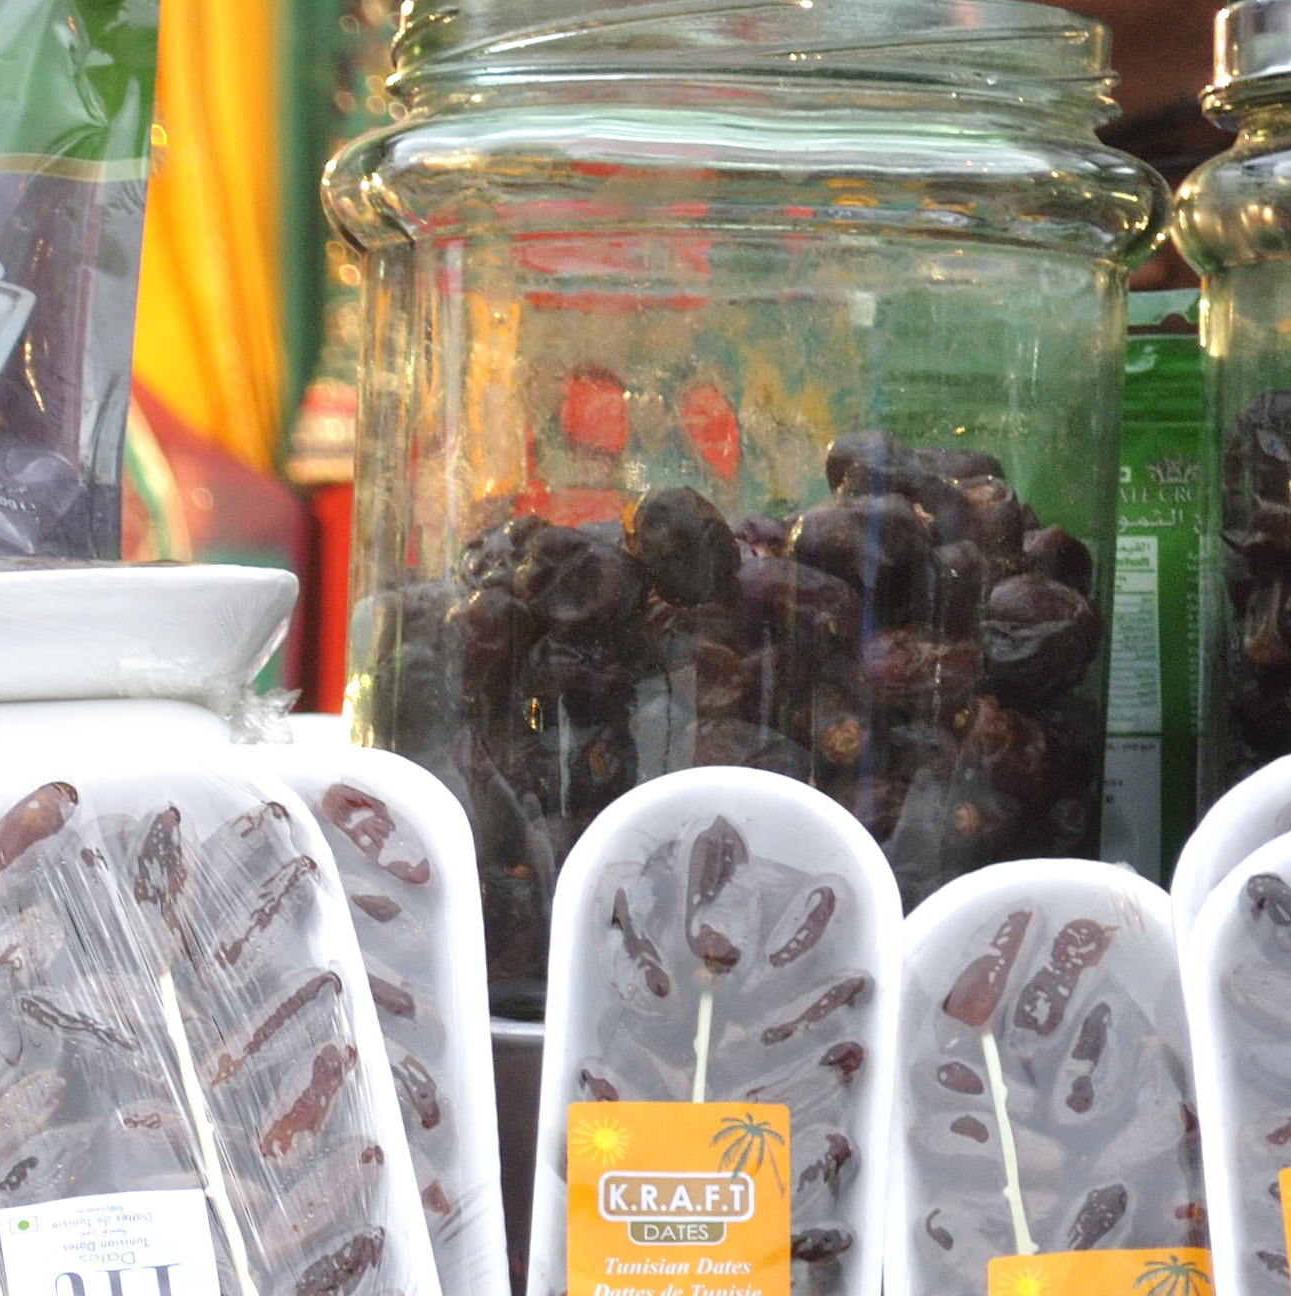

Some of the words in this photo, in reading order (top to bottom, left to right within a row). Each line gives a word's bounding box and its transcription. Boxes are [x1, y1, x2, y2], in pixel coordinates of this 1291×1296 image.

[609, 1183, 745, 1212] K.R.A.F.T
[644, 1224, 709, 1240] DATES
[605, 1257, 689, 1275] Tunisian
[696, 1257, 752, 1275] Dates
